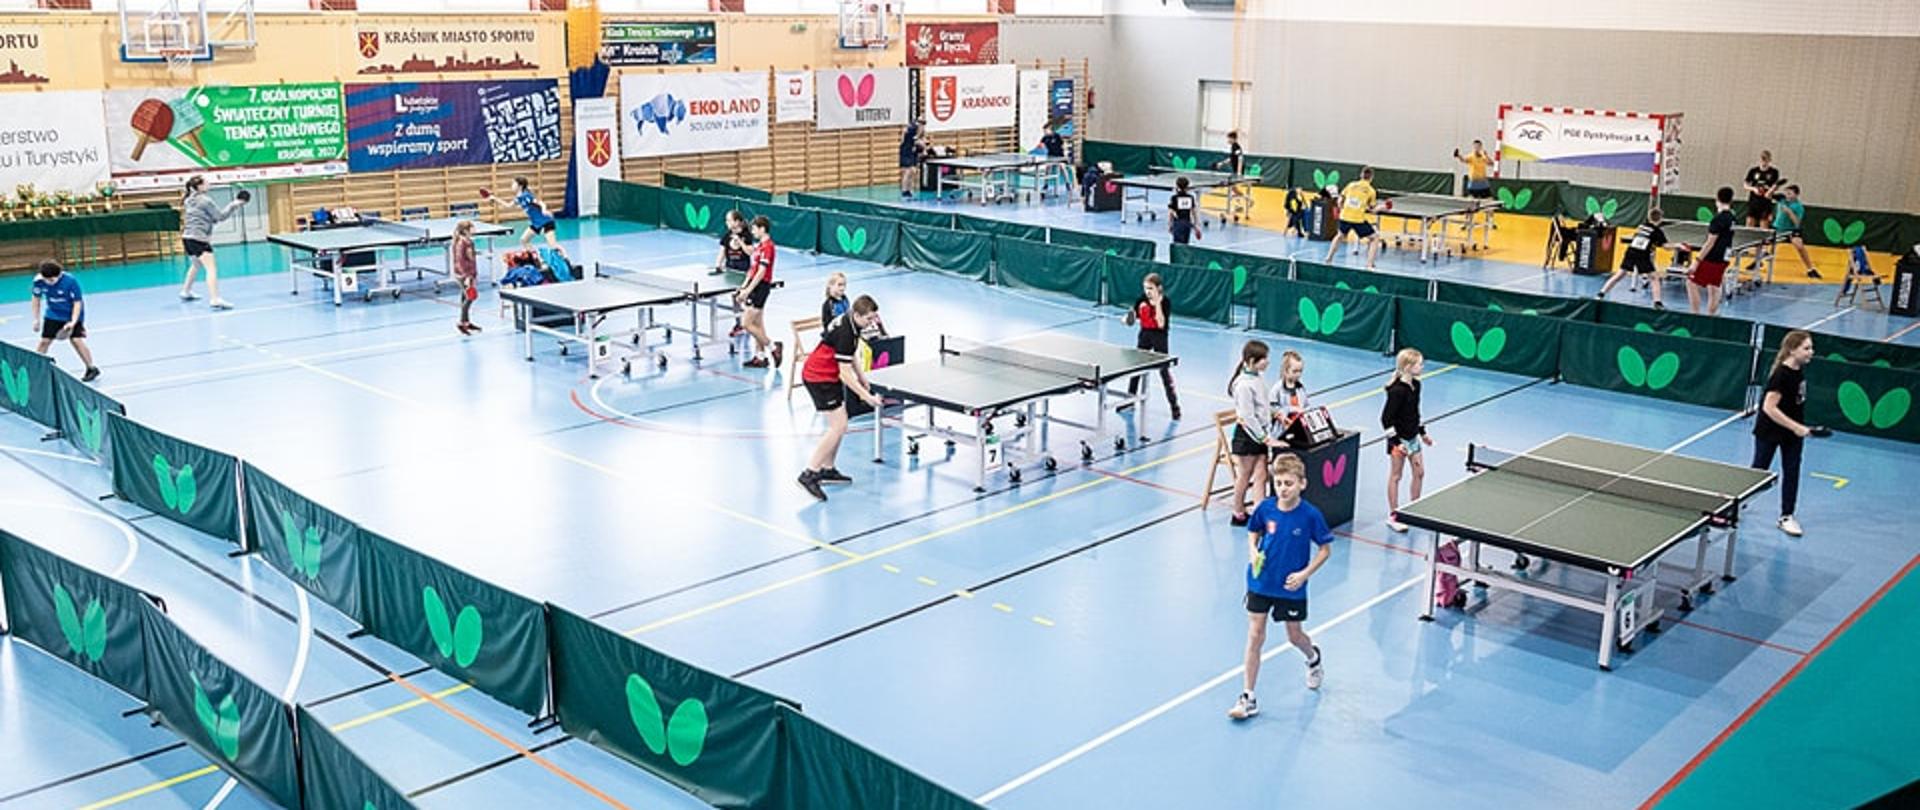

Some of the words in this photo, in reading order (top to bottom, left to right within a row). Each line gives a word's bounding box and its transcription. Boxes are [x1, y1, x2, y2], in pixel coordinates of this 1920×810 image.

[385, 27, 439, 44] KRAŚNIK
[442, 30, 487, 43] MIASTO
[491, 30, 535, 43] SPORTU
[689, 98, 761, 116] EKOLAND
[961, 95, 1010, 108] KRAŚNICKI
[213, 105, 290, 124] ŚWIĄTECZNY
[291, 103, 339, 119] TURNIEJ
[856, 108, 891, 122] BUTTERFLY
[223, 124, 267, 140] TENISA
[270, 121, 341, 138] STOŁOWEGO
[406, 122, 441, 138] dumą
[1518, 129, 1543, 141] PGE
[1563, 128, 1581, 138] PGE
[367, 141, 435, 157] wspieramy
[437, 137, 468, 153] sport
[24, 147, 99, 168] Turystyki
[989, 449, 997, 463] 7
